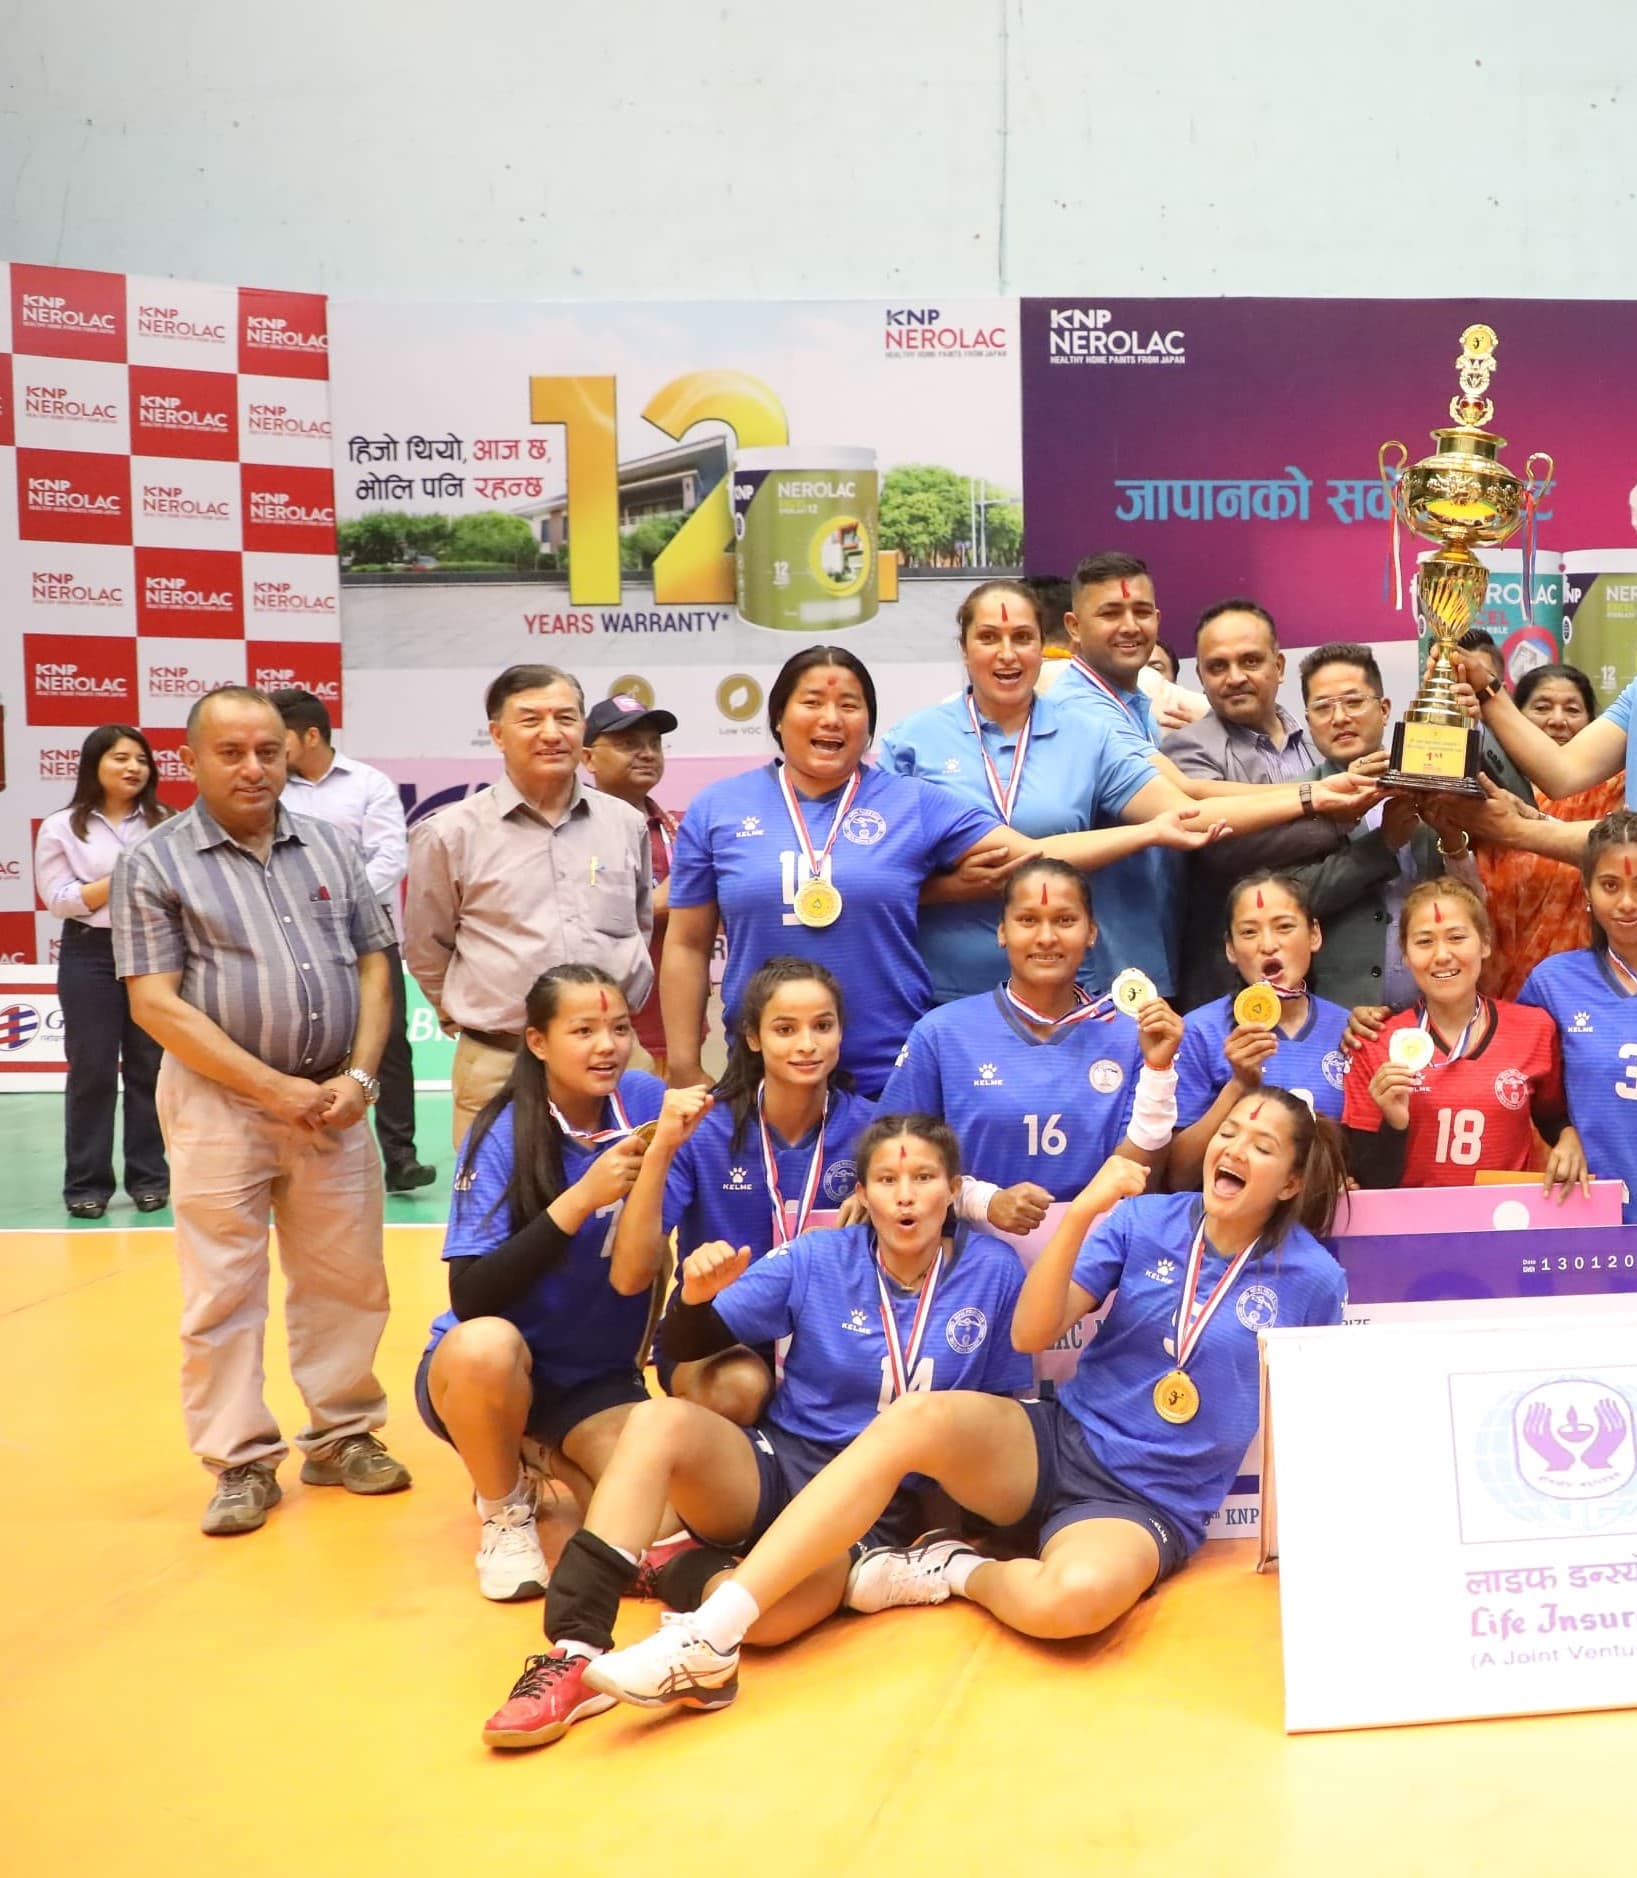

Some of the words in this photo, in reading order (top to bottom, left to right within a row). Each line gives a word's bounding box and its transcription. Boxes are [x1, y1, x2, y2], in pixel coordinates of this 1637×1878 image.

[23, 294, 65, 308] KNP
[23, 307, 115, 329] NEROLAC
[139, 306, 178, 319] KNP
[886, 309, 940, 326] KNP
[1050, 309, 1112, 328] KNP
[138, 319, 225, 339] NEROLAC
[247, 316, 287, 329] KNP
[247, 328, 328, 348] NEROLAC
[885, 328, 1006, 349] NEROLAC
[1050, 330, 1185, 354] NEROLAC
[1050, 355, 1083, 364] HEALTHY
[1085, 355, 1107, 364] HOME
[1109, 355, 1136, 364] PAINTS
[1138, 355, 1159, 364] FROM
[1160, 355, 1185, 364] JAPAN
[26, 386, 67, 399] KNP
[26, 400, 117, 419] NEROLAC
[140, 395, 181, 409] KNP
[249, 404, 287, 417] KNP
[140, 409, 228, 429] NEROLAC
[249, 416, 332, 434] NEROLAC
[348, 434, 398, 463] हिजो
[406, 433, 467, 464] थियो,
[473, 439, 520, 461] आज
[28, 478, 71, 492] KNP
[143, 486, 183, 499] KNP
[356, 472, 413, 500] भोलि
[421, 472, 465, 498] पनि
[473, 477, 543, 500] रहन्छ
[530, 368, 899, 607] 12
[777, 482, 856, 498] NEROLAC
[1114, 466, 1312, 521] जापानको
[28, 491, 121, 510] NEROLAC
[143, 499, 230, 516] NEROLAC
[251, 493, 290, 506] KNP
[251, 505, 334, 522] NEROLAC
[773, 561, 789, 575] 12
[33, 572, 74, 585] KNP
[146, 577, 187, 590] KNP
[33, 585, 122, 604] NEROLAC
[253, 582, 292, 595] KNP
[1485, 583, 1557, 605] ROAC
[146, 590, 233, 607] NEROLAC
[253, 594, 336, 611] NEROLAC
[524, 614, 594, 635] YEARS
[35, 664, 77, 677] KNP
[149, 667, 188, 677] KNP
[256, 669, 295, 681] KNP
[1601, 666, 1616, 681] 12
[35, 676, 127, 695] NEROLAC
[40, 750, 80, 761] KNP
[736, 830, 764, 838] KELME
[973, 1079, 1004, 1087] KELME
[1023, 1113, 1067, 1157] 16
[1435, 1107, 1486, 1166] 18
[723, 1183, 753, 1191] KELME
[1145, 1270, 1175, 1285] KELME
[841, 1323, 872, 1335] KELME
[1225, 1508, 1259, 1526] KNP
[1466, 1566, 1557, 1595] लाइफ
[1471, 1606, 1527, 1640] Life
[1471, 1651, 1496, 1669] (A
[1503, 1648, 1559, 1665] Joint
